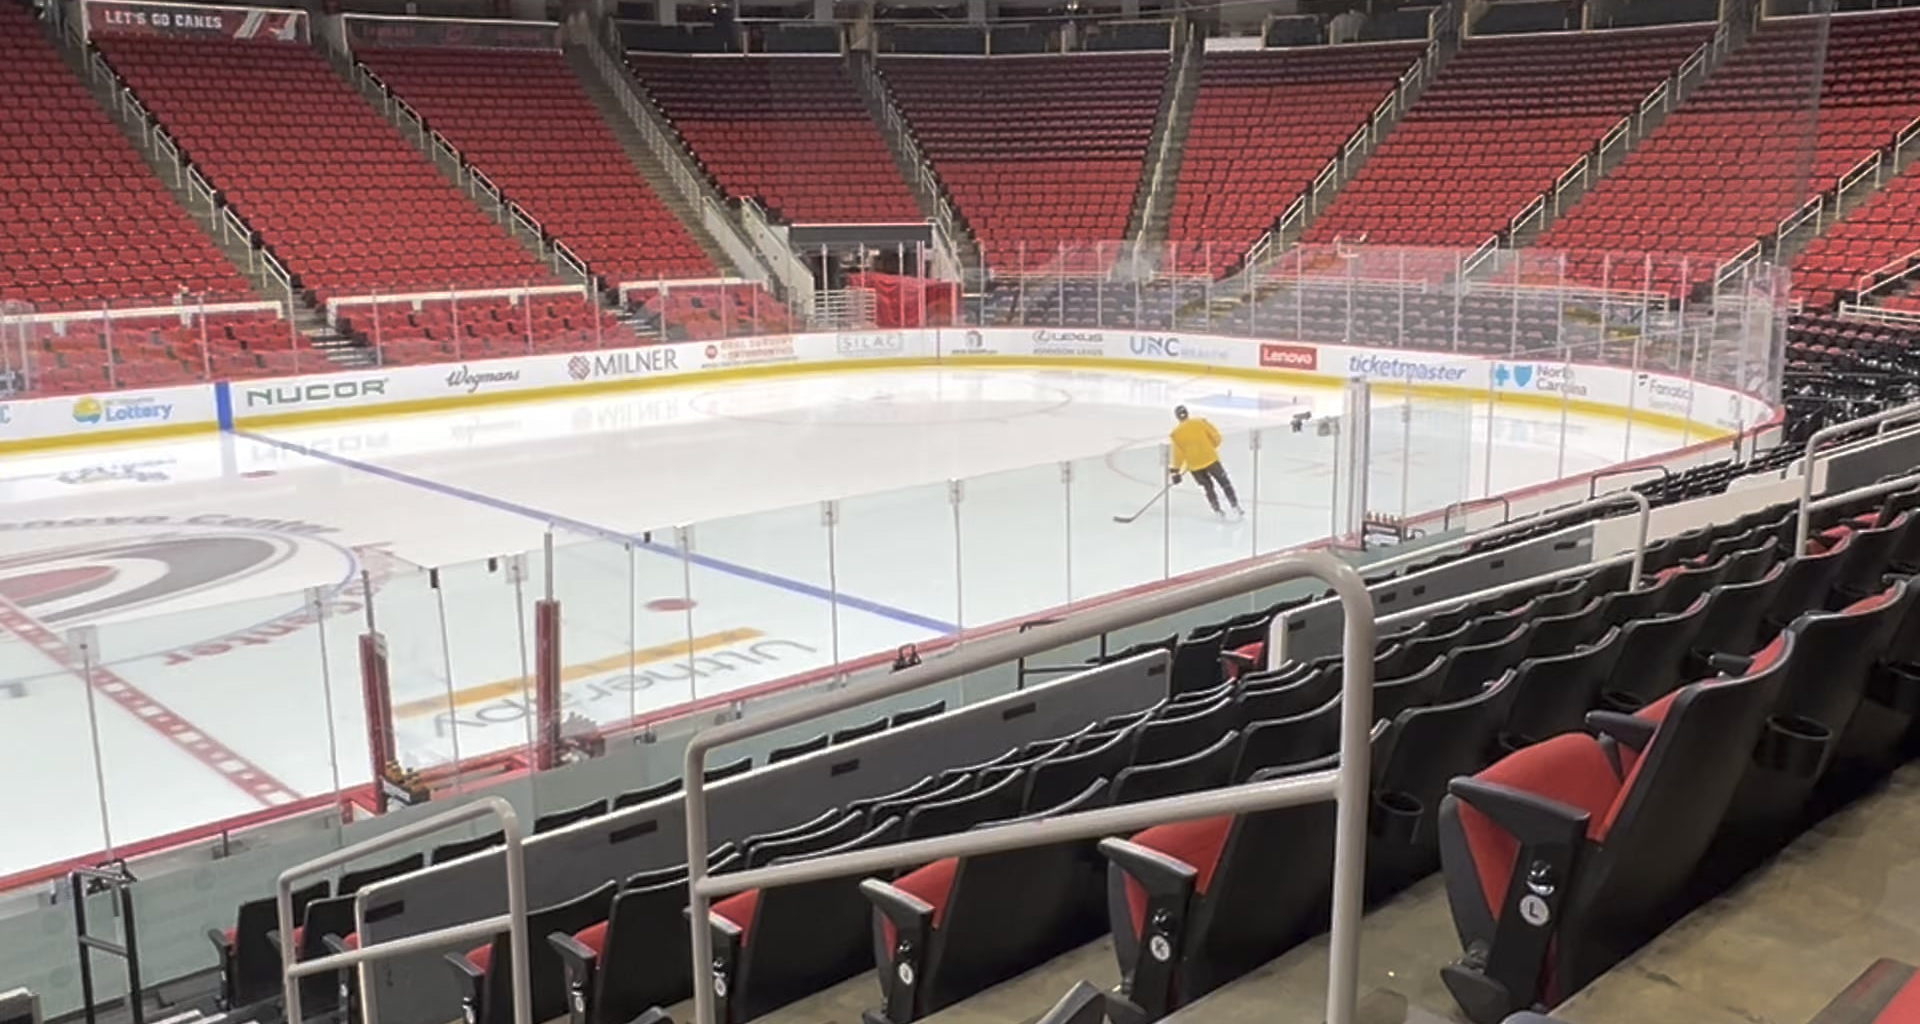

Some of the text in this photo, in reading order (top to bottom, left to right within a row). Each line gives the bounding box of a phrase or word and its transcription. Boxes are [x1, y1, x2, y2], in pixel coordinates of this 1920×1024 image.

[104, 10, 223, 29] LET'S GO CANES
[1129, 335, 1180, 357] UNC
[1262, 347, 1313, 365] Lenovo
[594, 348, 679, 377] MILNER
[1349, 354, 1466, 381] ticketmaster
[446, 364, 521, 393] Wegmans
[247, 378, 386, 407] NUCOR
[106, 403, 173, 422] Lottery
